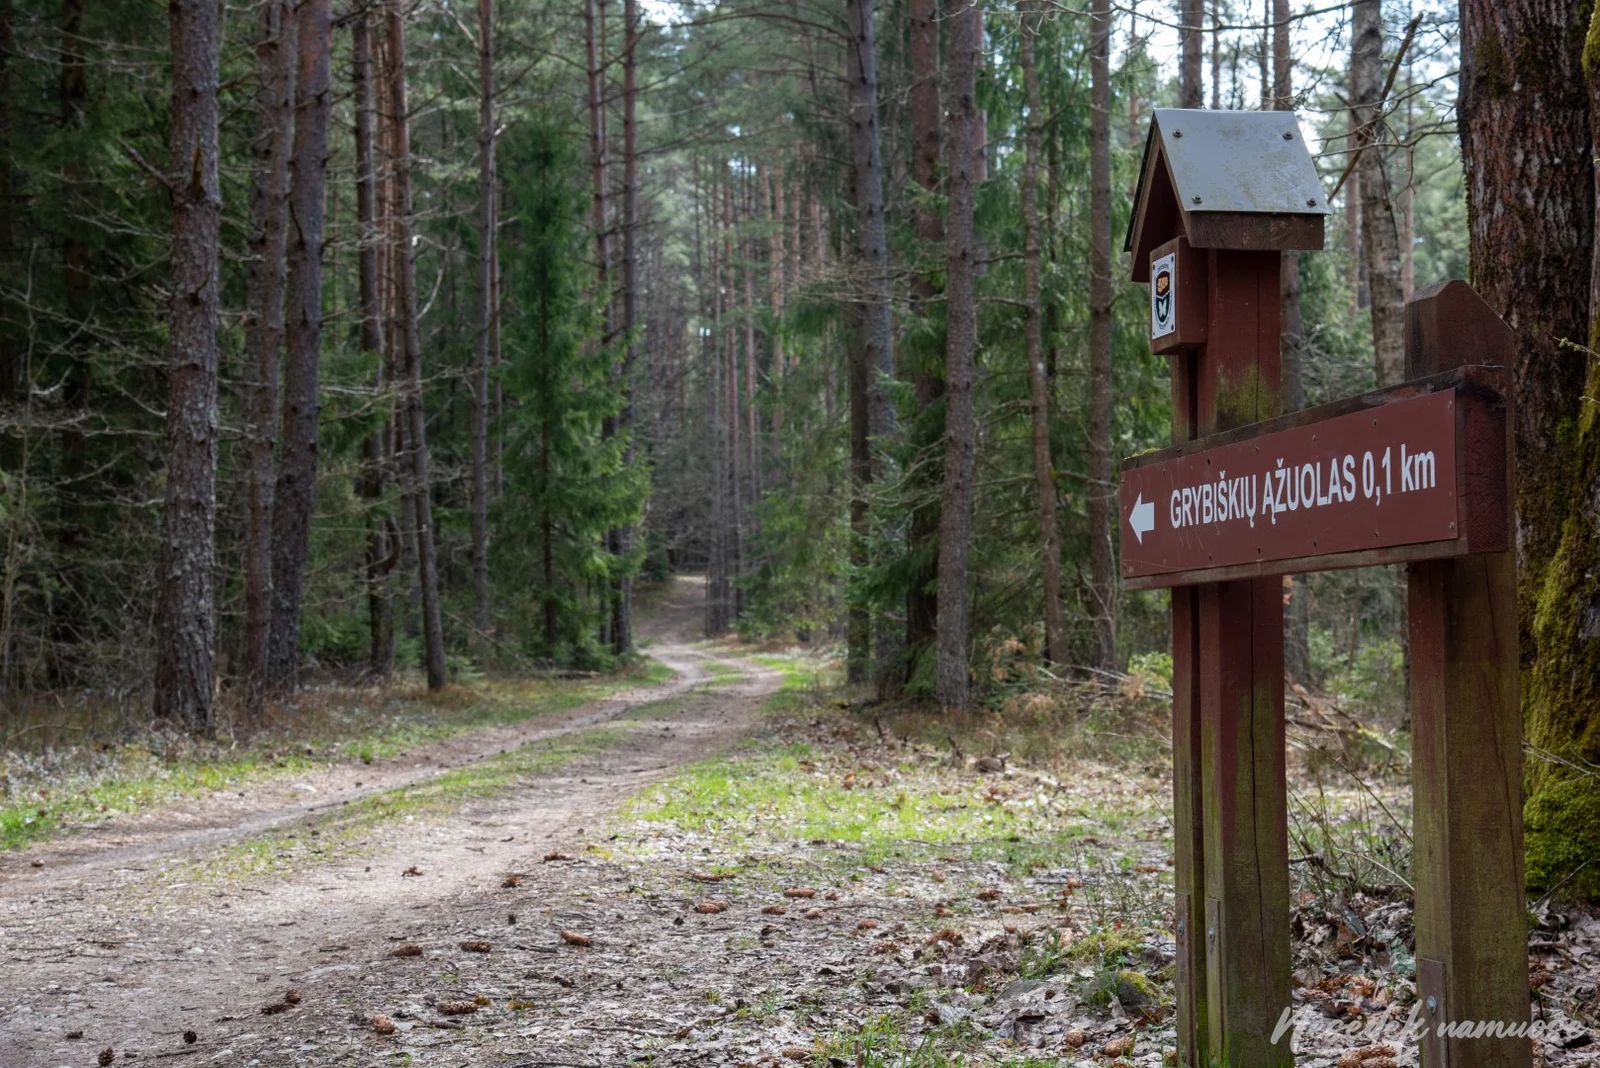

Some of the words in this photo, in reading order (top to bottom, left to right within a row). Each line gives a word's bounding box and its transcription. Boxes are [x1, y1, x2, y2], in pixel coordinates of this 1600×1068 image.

[1170, 470, 1257, 529] GRYBIŠKIŲ
[1262, 455, 1357, 525] ĄŽUOLAS
[1362, 447, 1392, 507] 0,1
[1400, 443, 1436, 493] km
